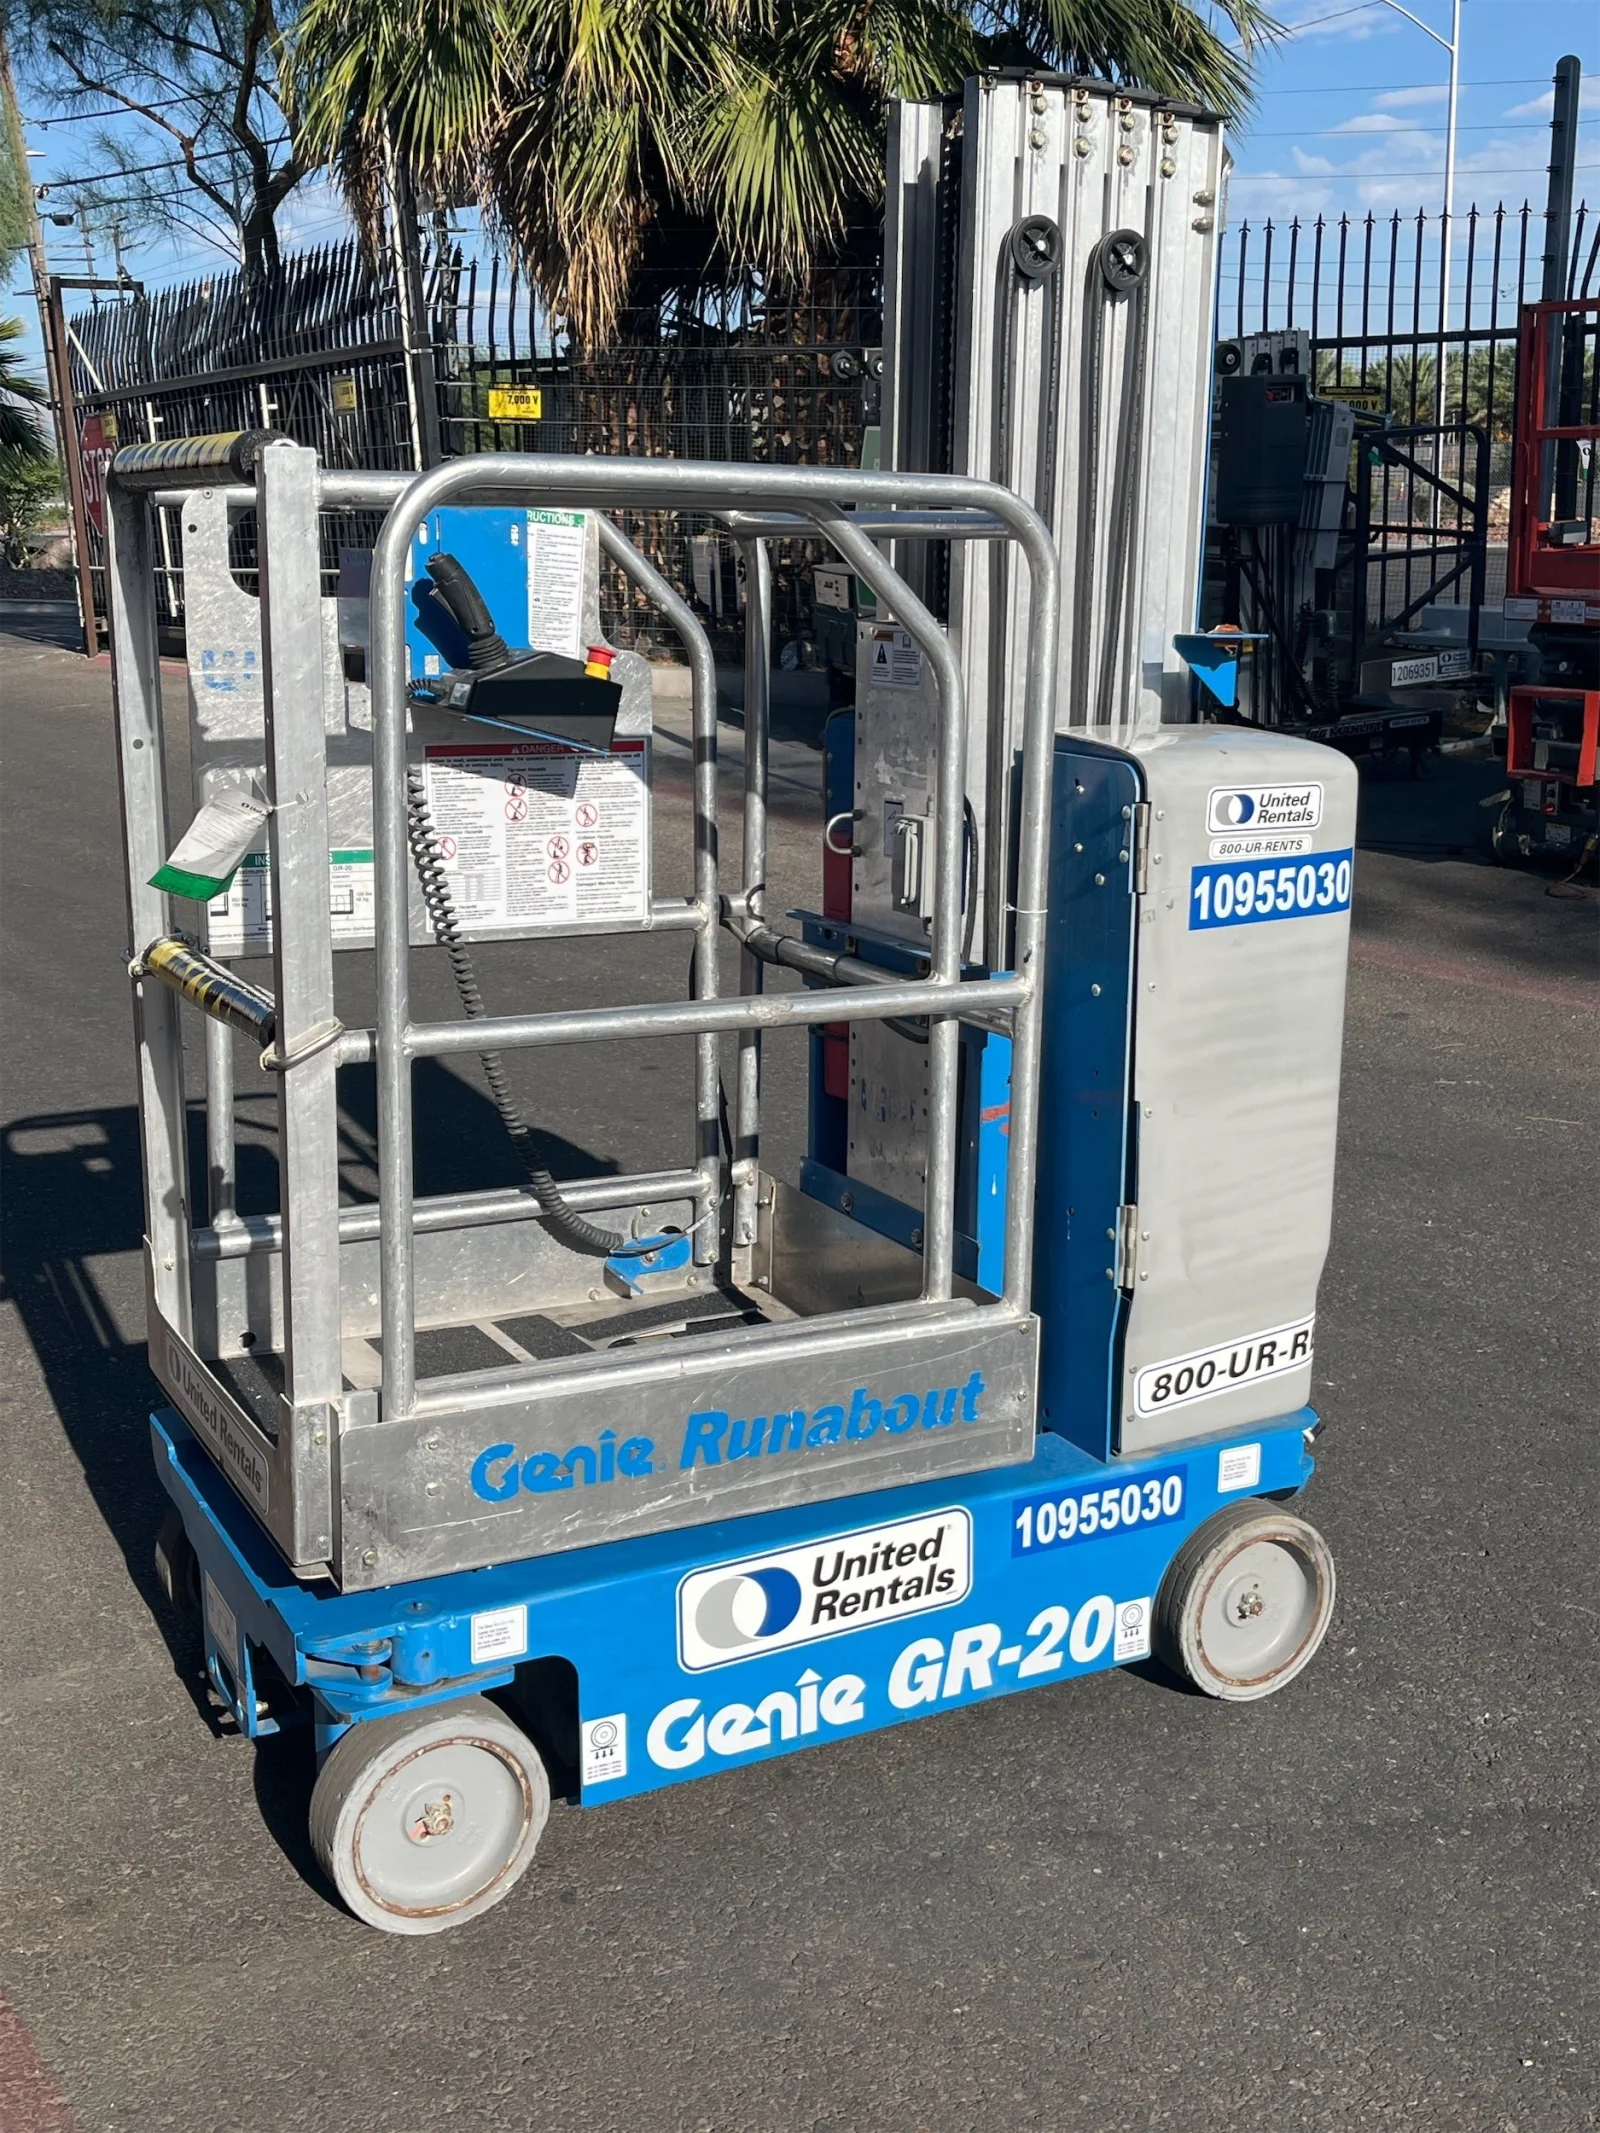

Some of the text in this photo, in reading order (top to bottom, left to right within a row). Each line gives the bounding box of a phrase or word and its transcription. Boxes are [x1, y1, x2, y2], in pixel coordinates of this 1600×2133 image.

[507, 395, 539, 405] 7,000 V
[1341, 400, 1368, 411] 000
[1392, 662, 1435, 682] 12069351
[1257, 808, 1313, 824] Rentals
[1259, 792, 1311, 808] United
[1219, 840, 1303, 855] 800-UR-RENTS
[1194, 860, 1350, 921] 10955030
[1151, 1328, 1314, 1403] 800-UR-R
[183, 1365, 263, 1494] United Rentals
[679, 1371, 985, 1470] Runabout
[1016, 1474, 1182, 1548] 10955030
[812, 1527, 946, 1588] United
[810, 1564, 956, 1626] Rentals
[887, 1594, 1114, 1710] GR-20
